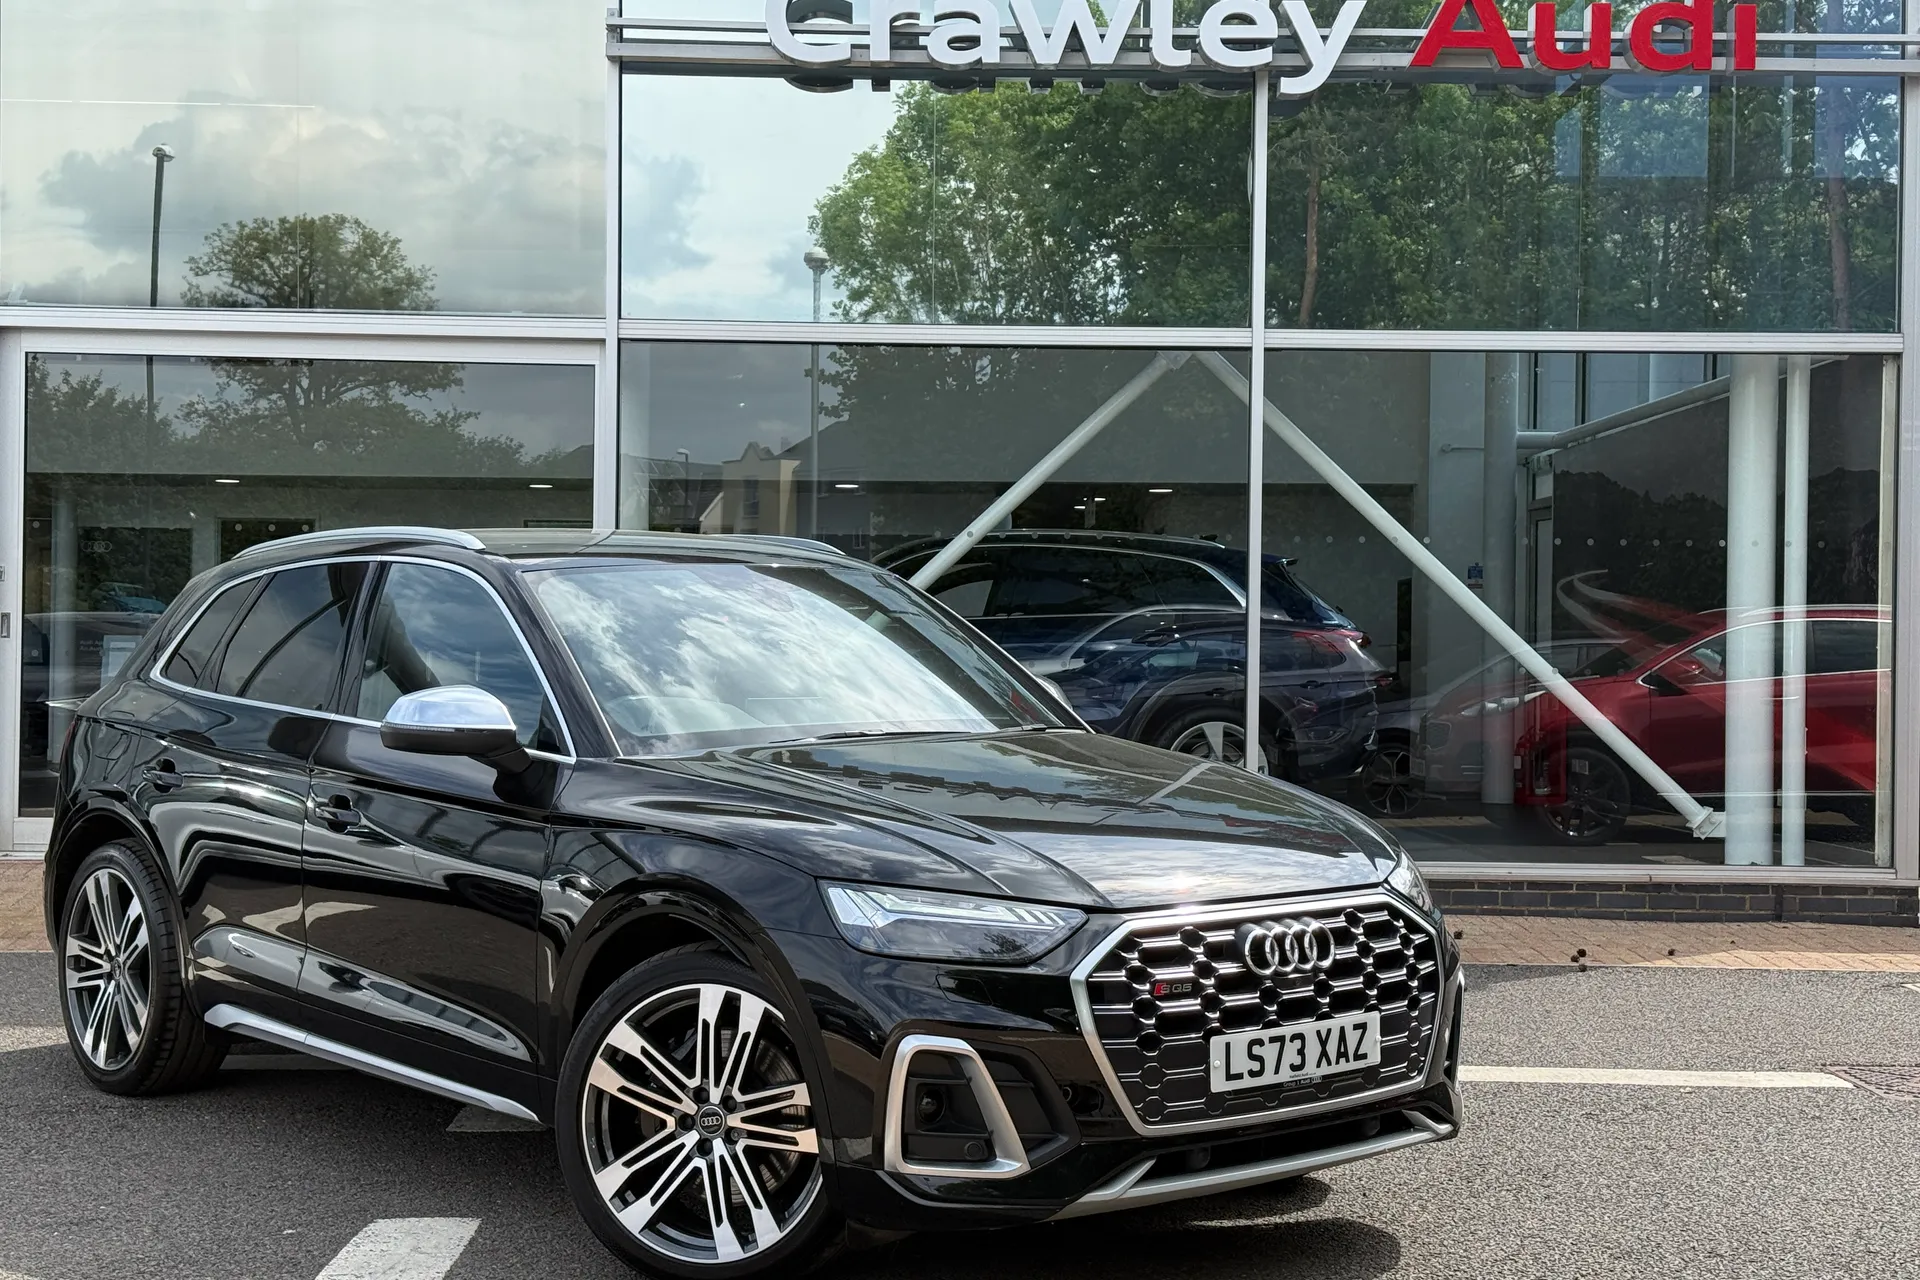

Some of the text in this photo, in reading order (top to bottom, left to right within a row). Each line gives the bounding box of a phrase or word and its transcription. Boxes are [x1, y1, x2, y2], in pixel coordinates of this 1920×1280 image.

[765, 0, 1757, 94] Crawley Audi
[1225, 1022, 1368, 1081] LS73 XAZ
